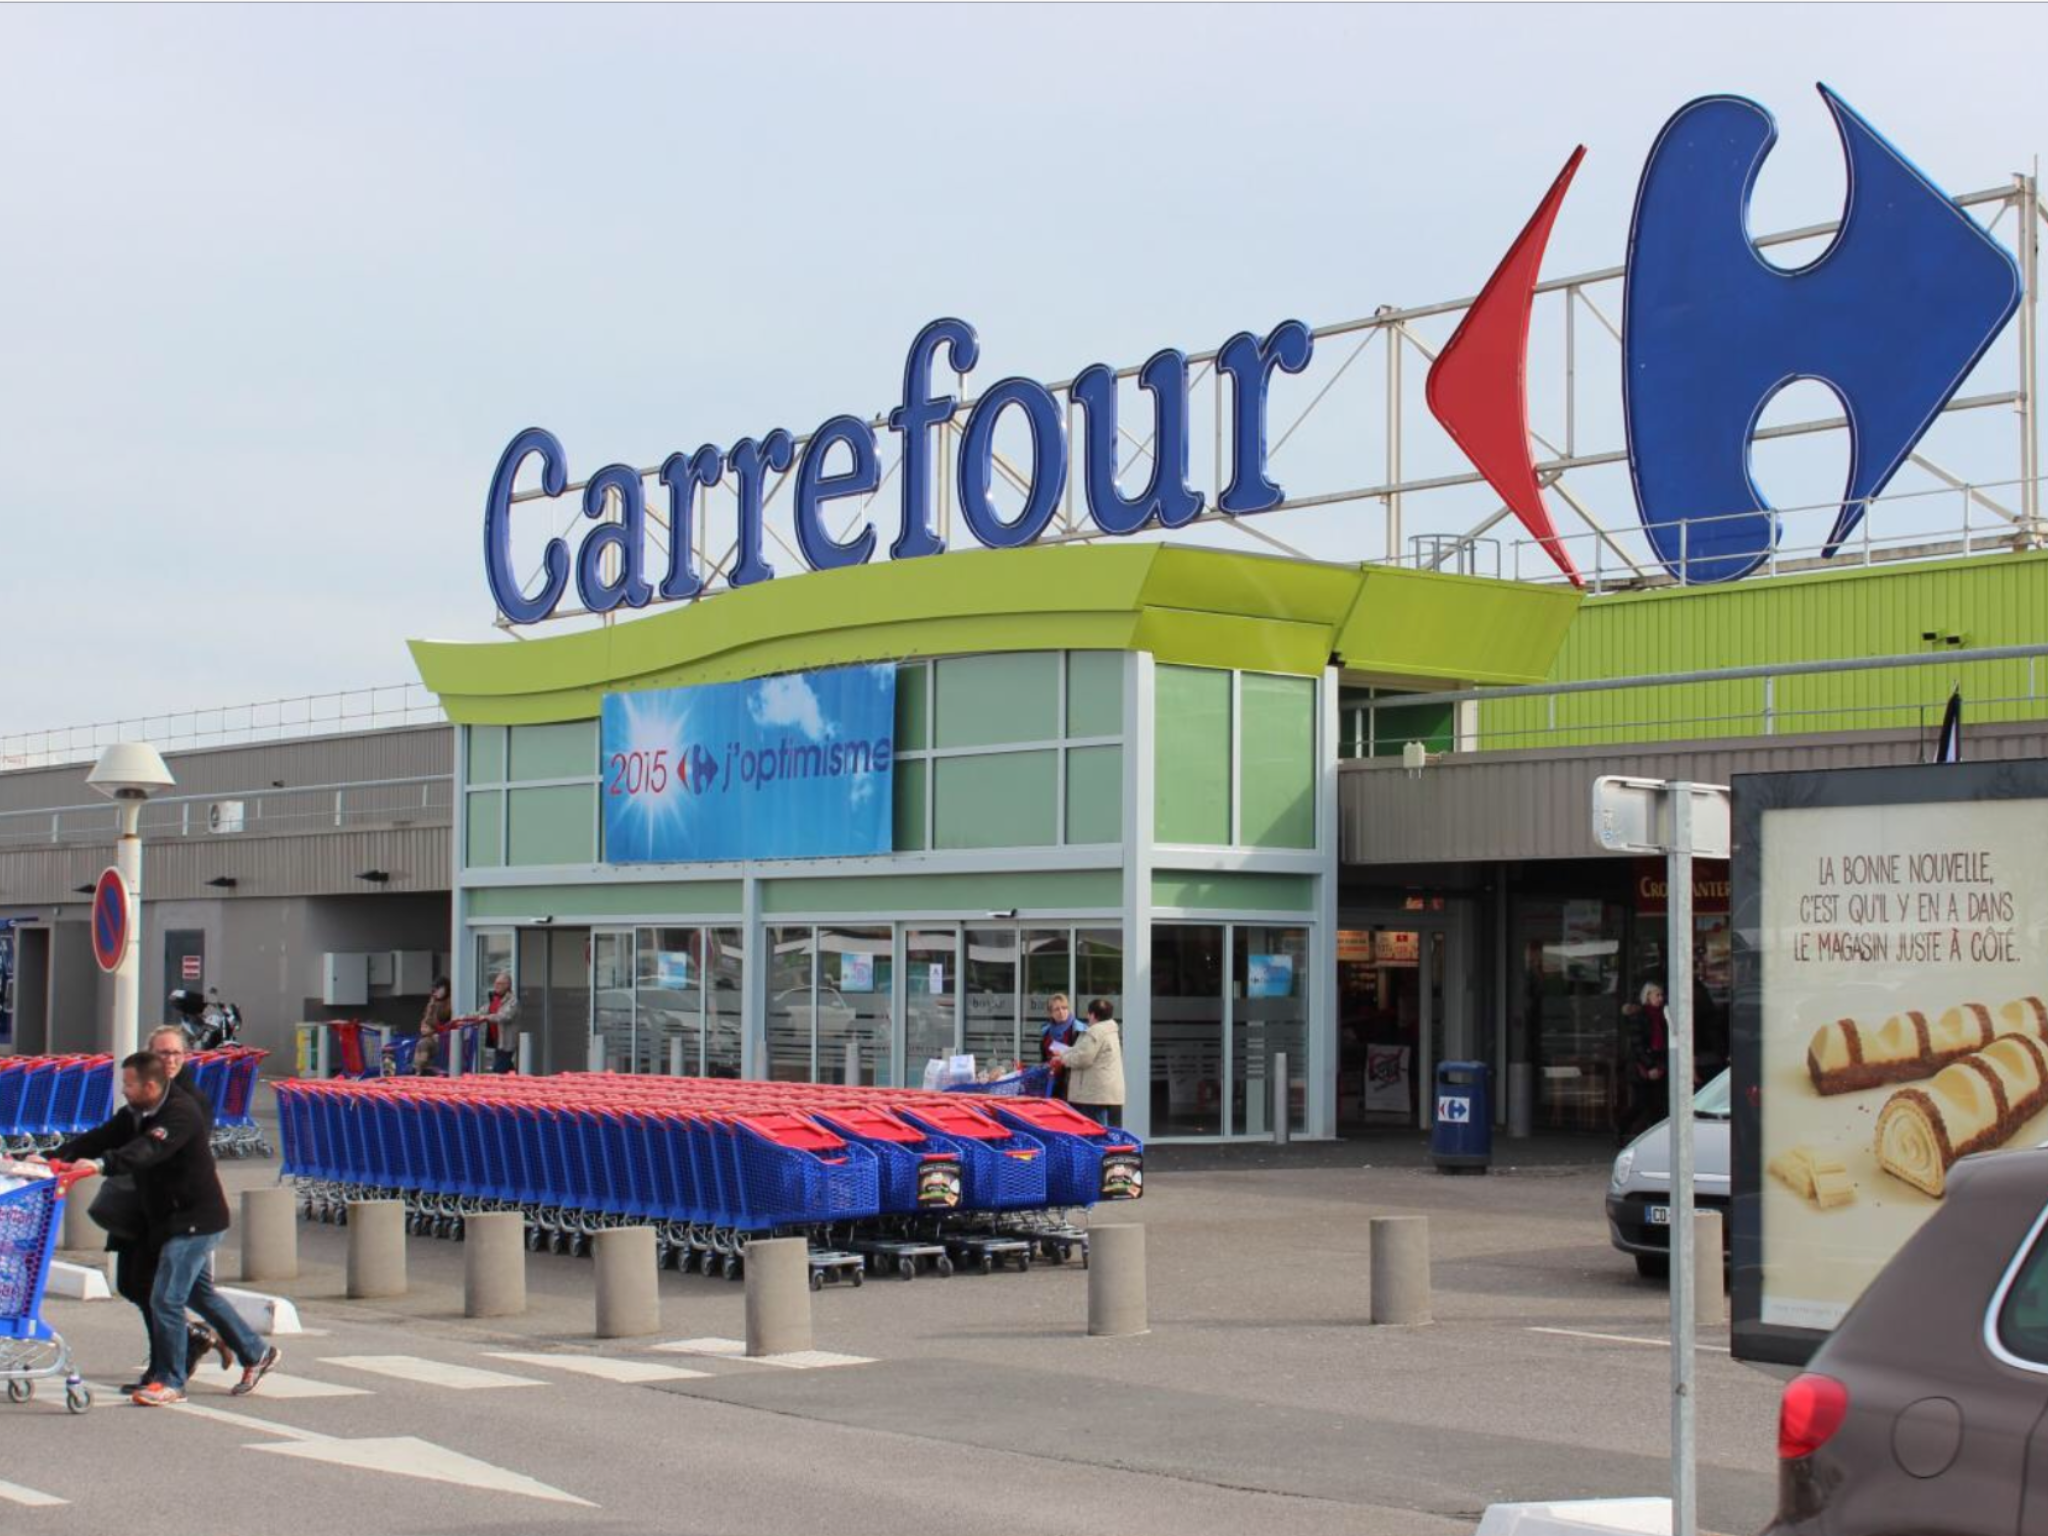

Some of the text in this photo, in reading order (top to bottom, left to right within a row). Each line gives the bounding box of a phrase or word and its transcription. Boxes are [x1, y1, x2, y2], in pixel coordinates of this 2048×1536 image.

[484, 317, 1314, 625] Carrefour
[609, 737, 891, 796] 2015 j'optimisme
[1819, 852, 1994, 886] LA BONNE NOUVELLE,
[1799, 891, 2015, 925] C'EST QU'IL Y EN A DANS
[1794, 926, 2021, 963] LE MAGASIN JUSTE À CÔTÉ.
